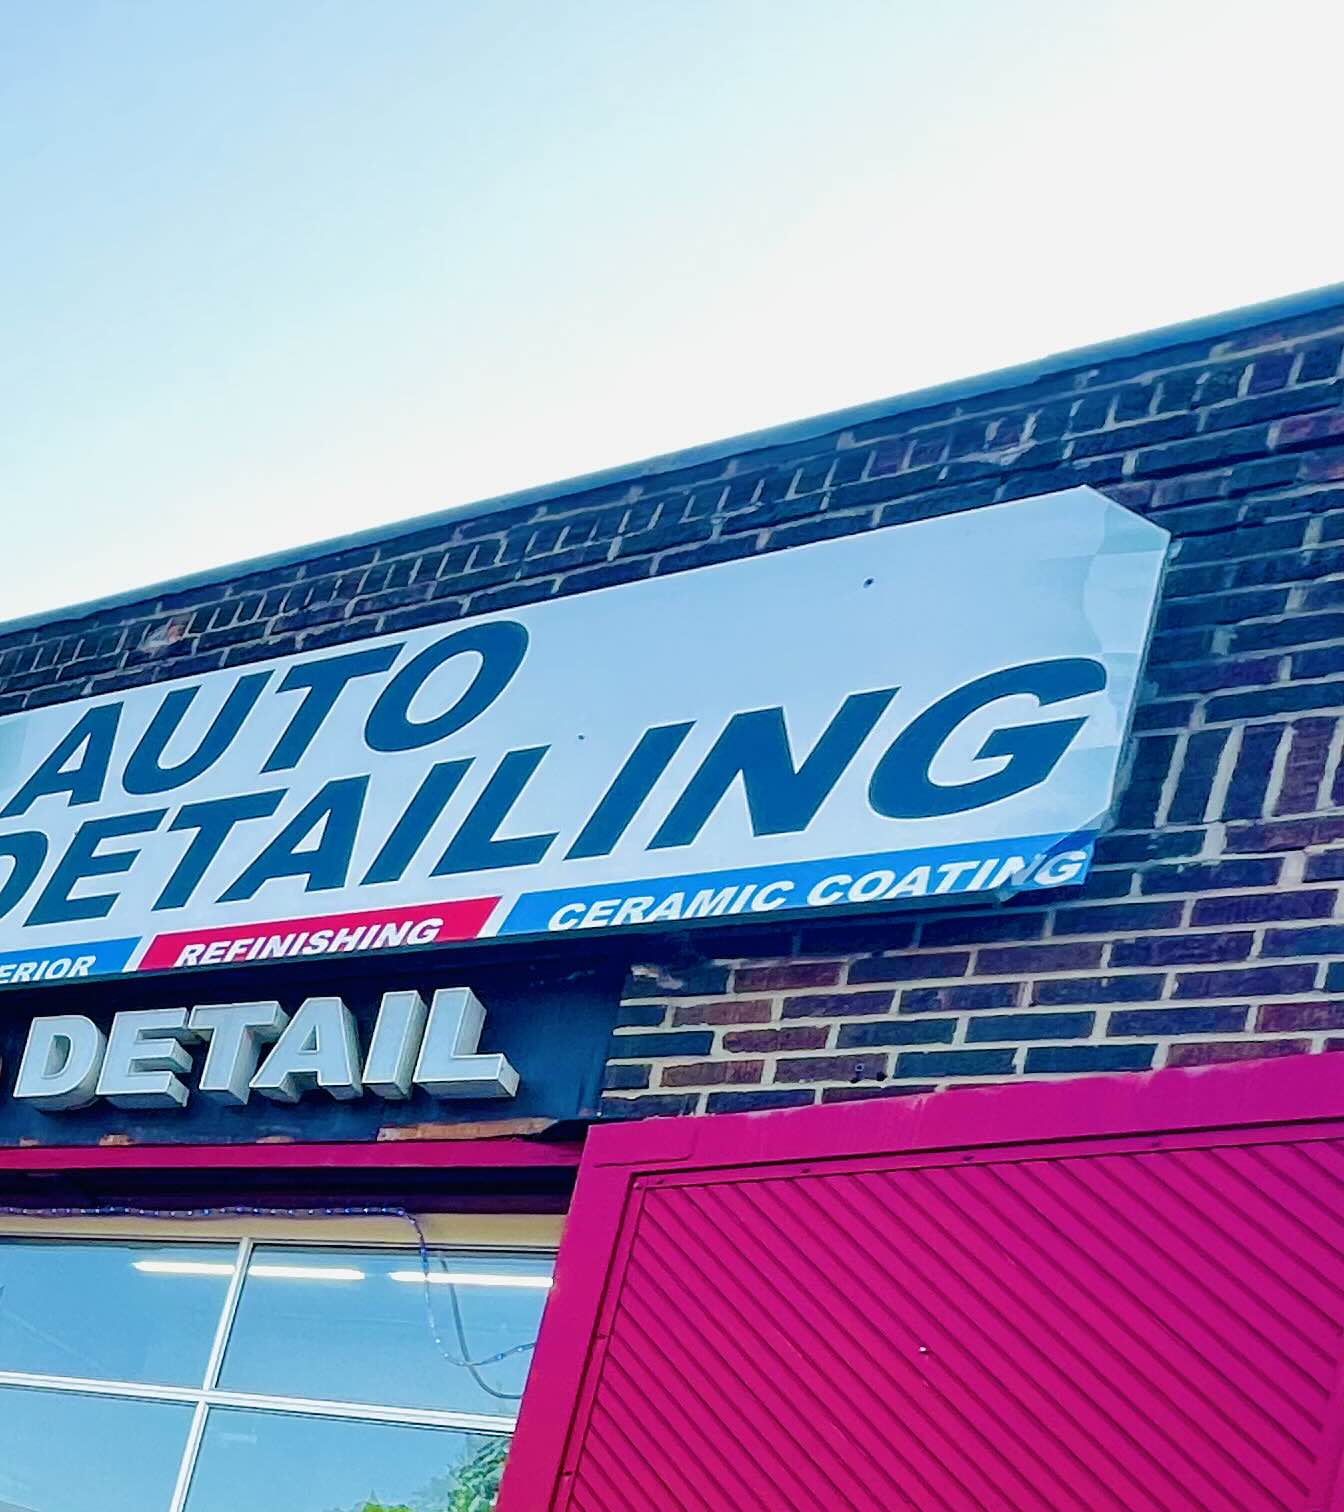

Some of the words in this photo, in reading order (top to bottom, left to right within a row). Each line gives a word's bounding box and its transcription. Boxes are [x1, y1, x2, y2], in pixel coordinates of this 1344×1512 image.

[547, 879, 796, 932] CERAMIC
[806, 850, 1089, 907] COATING
[173, 917, 444, 968] REFINISHING
[12, 987, 520, 1111] DETAIL
